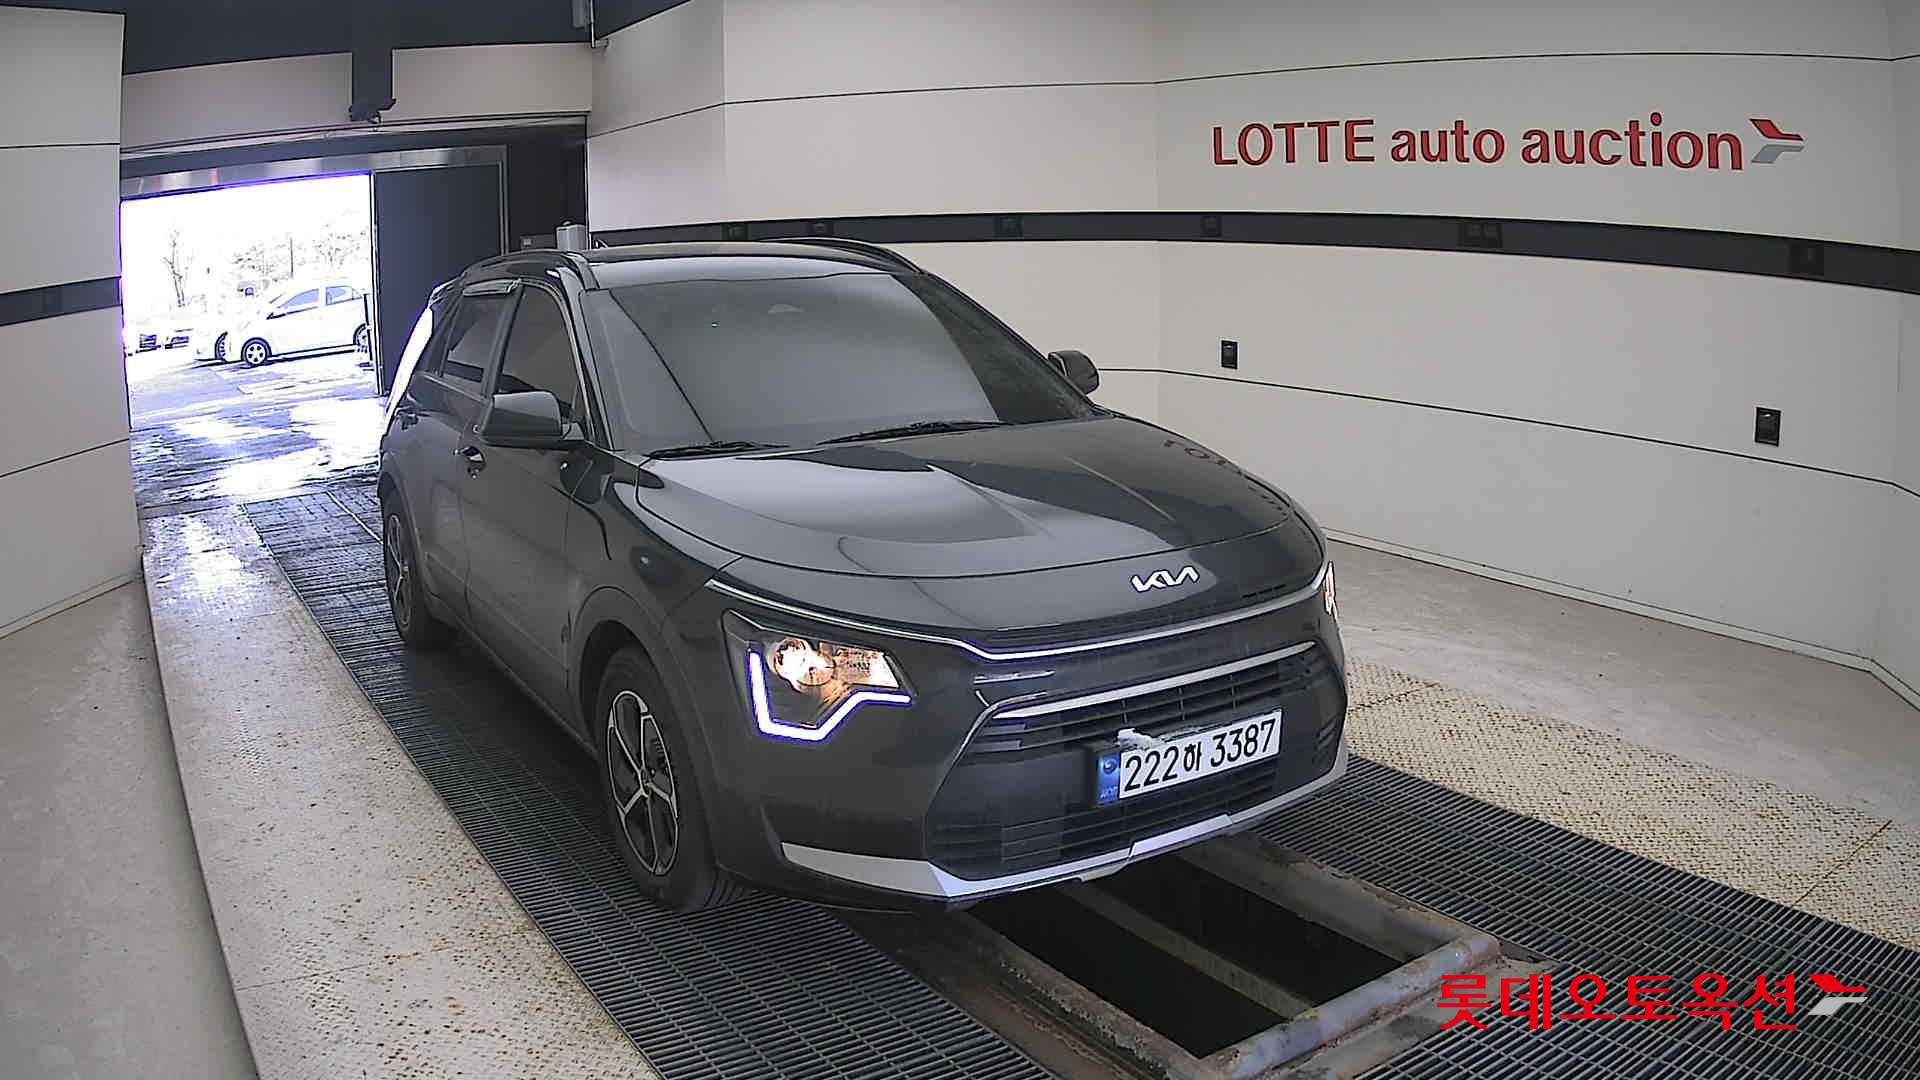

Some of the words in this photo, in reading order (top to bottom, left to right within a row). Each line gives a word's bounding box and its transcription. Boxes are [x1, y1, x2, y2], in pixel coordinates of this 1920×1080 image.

[1212, 119, 1376, 167] LOTTE
[1390, 120, 1506, 164] auto
[1520, 112, 1745, 171] auction
[1123, 742, 1203, 793] 222하
[1210, 718, 1277, 768] 3387
